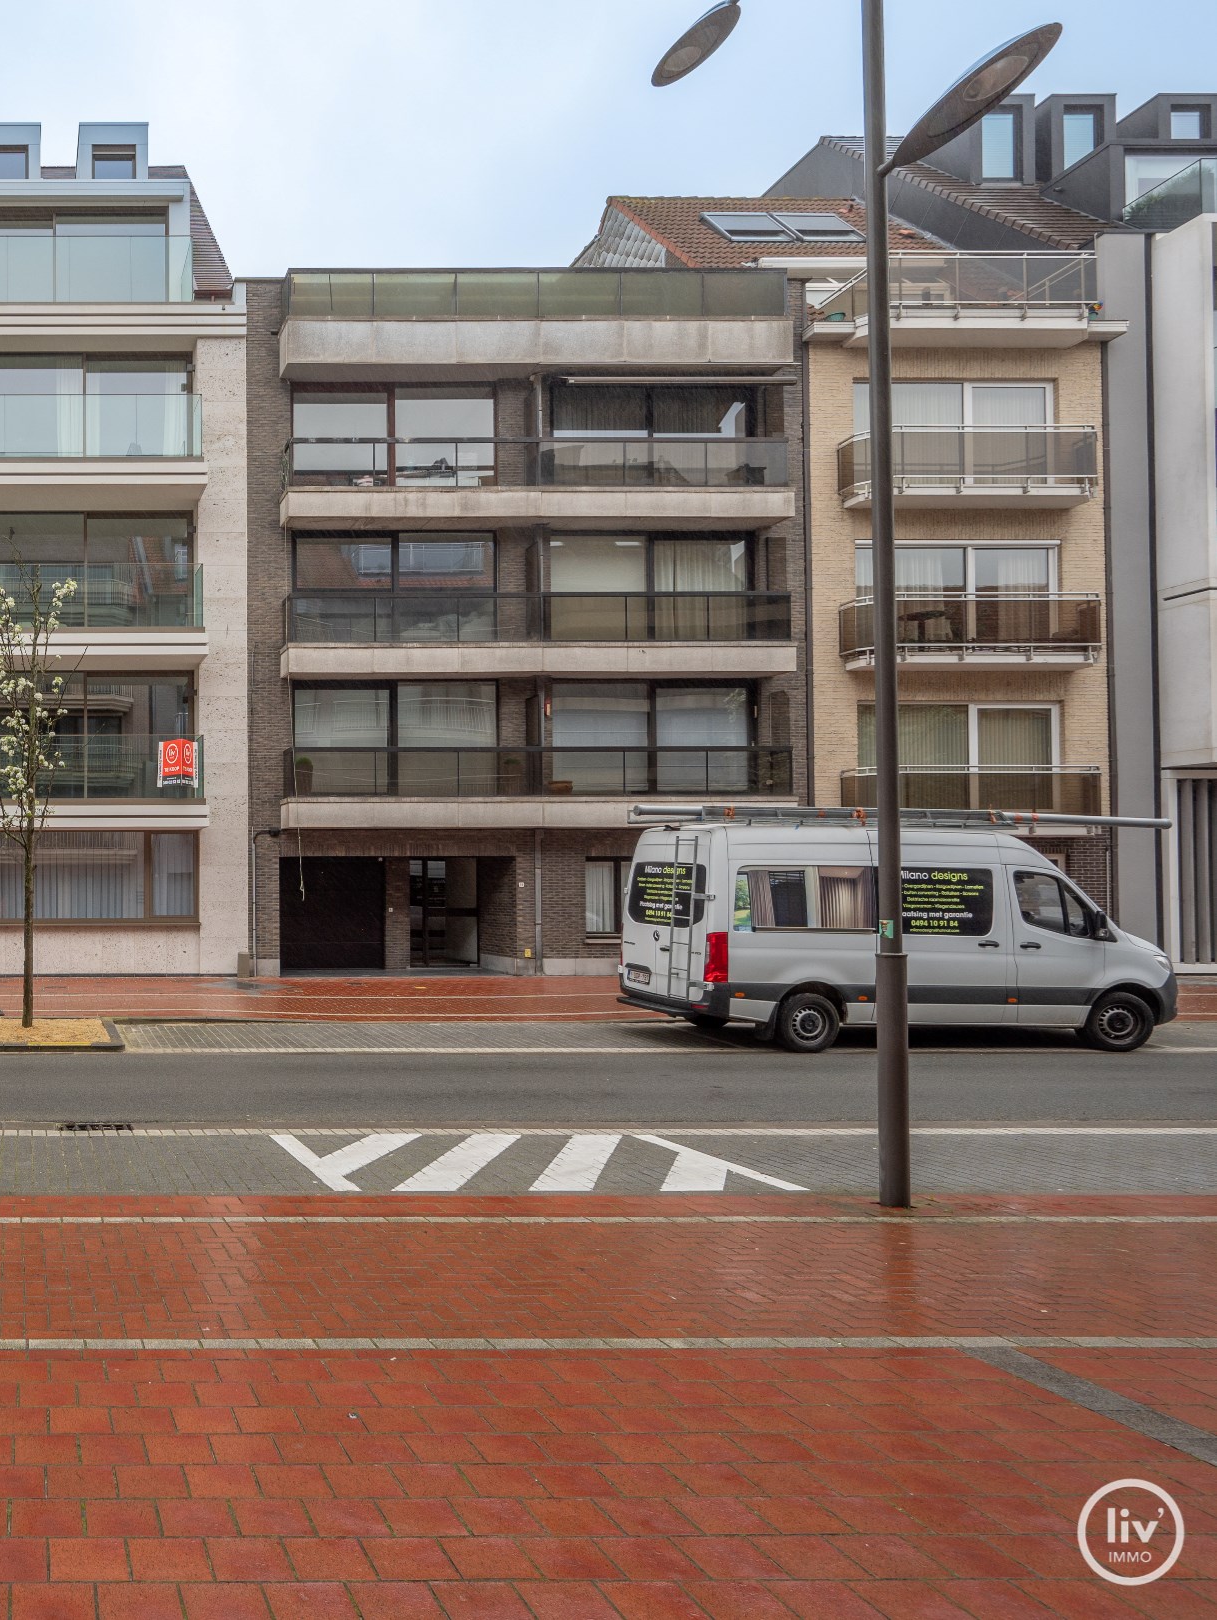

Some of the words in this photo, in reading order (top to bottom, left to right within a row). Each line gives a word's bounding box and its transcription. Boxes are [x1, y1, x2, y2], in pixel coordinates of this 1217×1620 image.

[644, 866, 662, 874] Milano
[663, 866, 686, 875] desgns
[931, 871, 968, 881] designs
